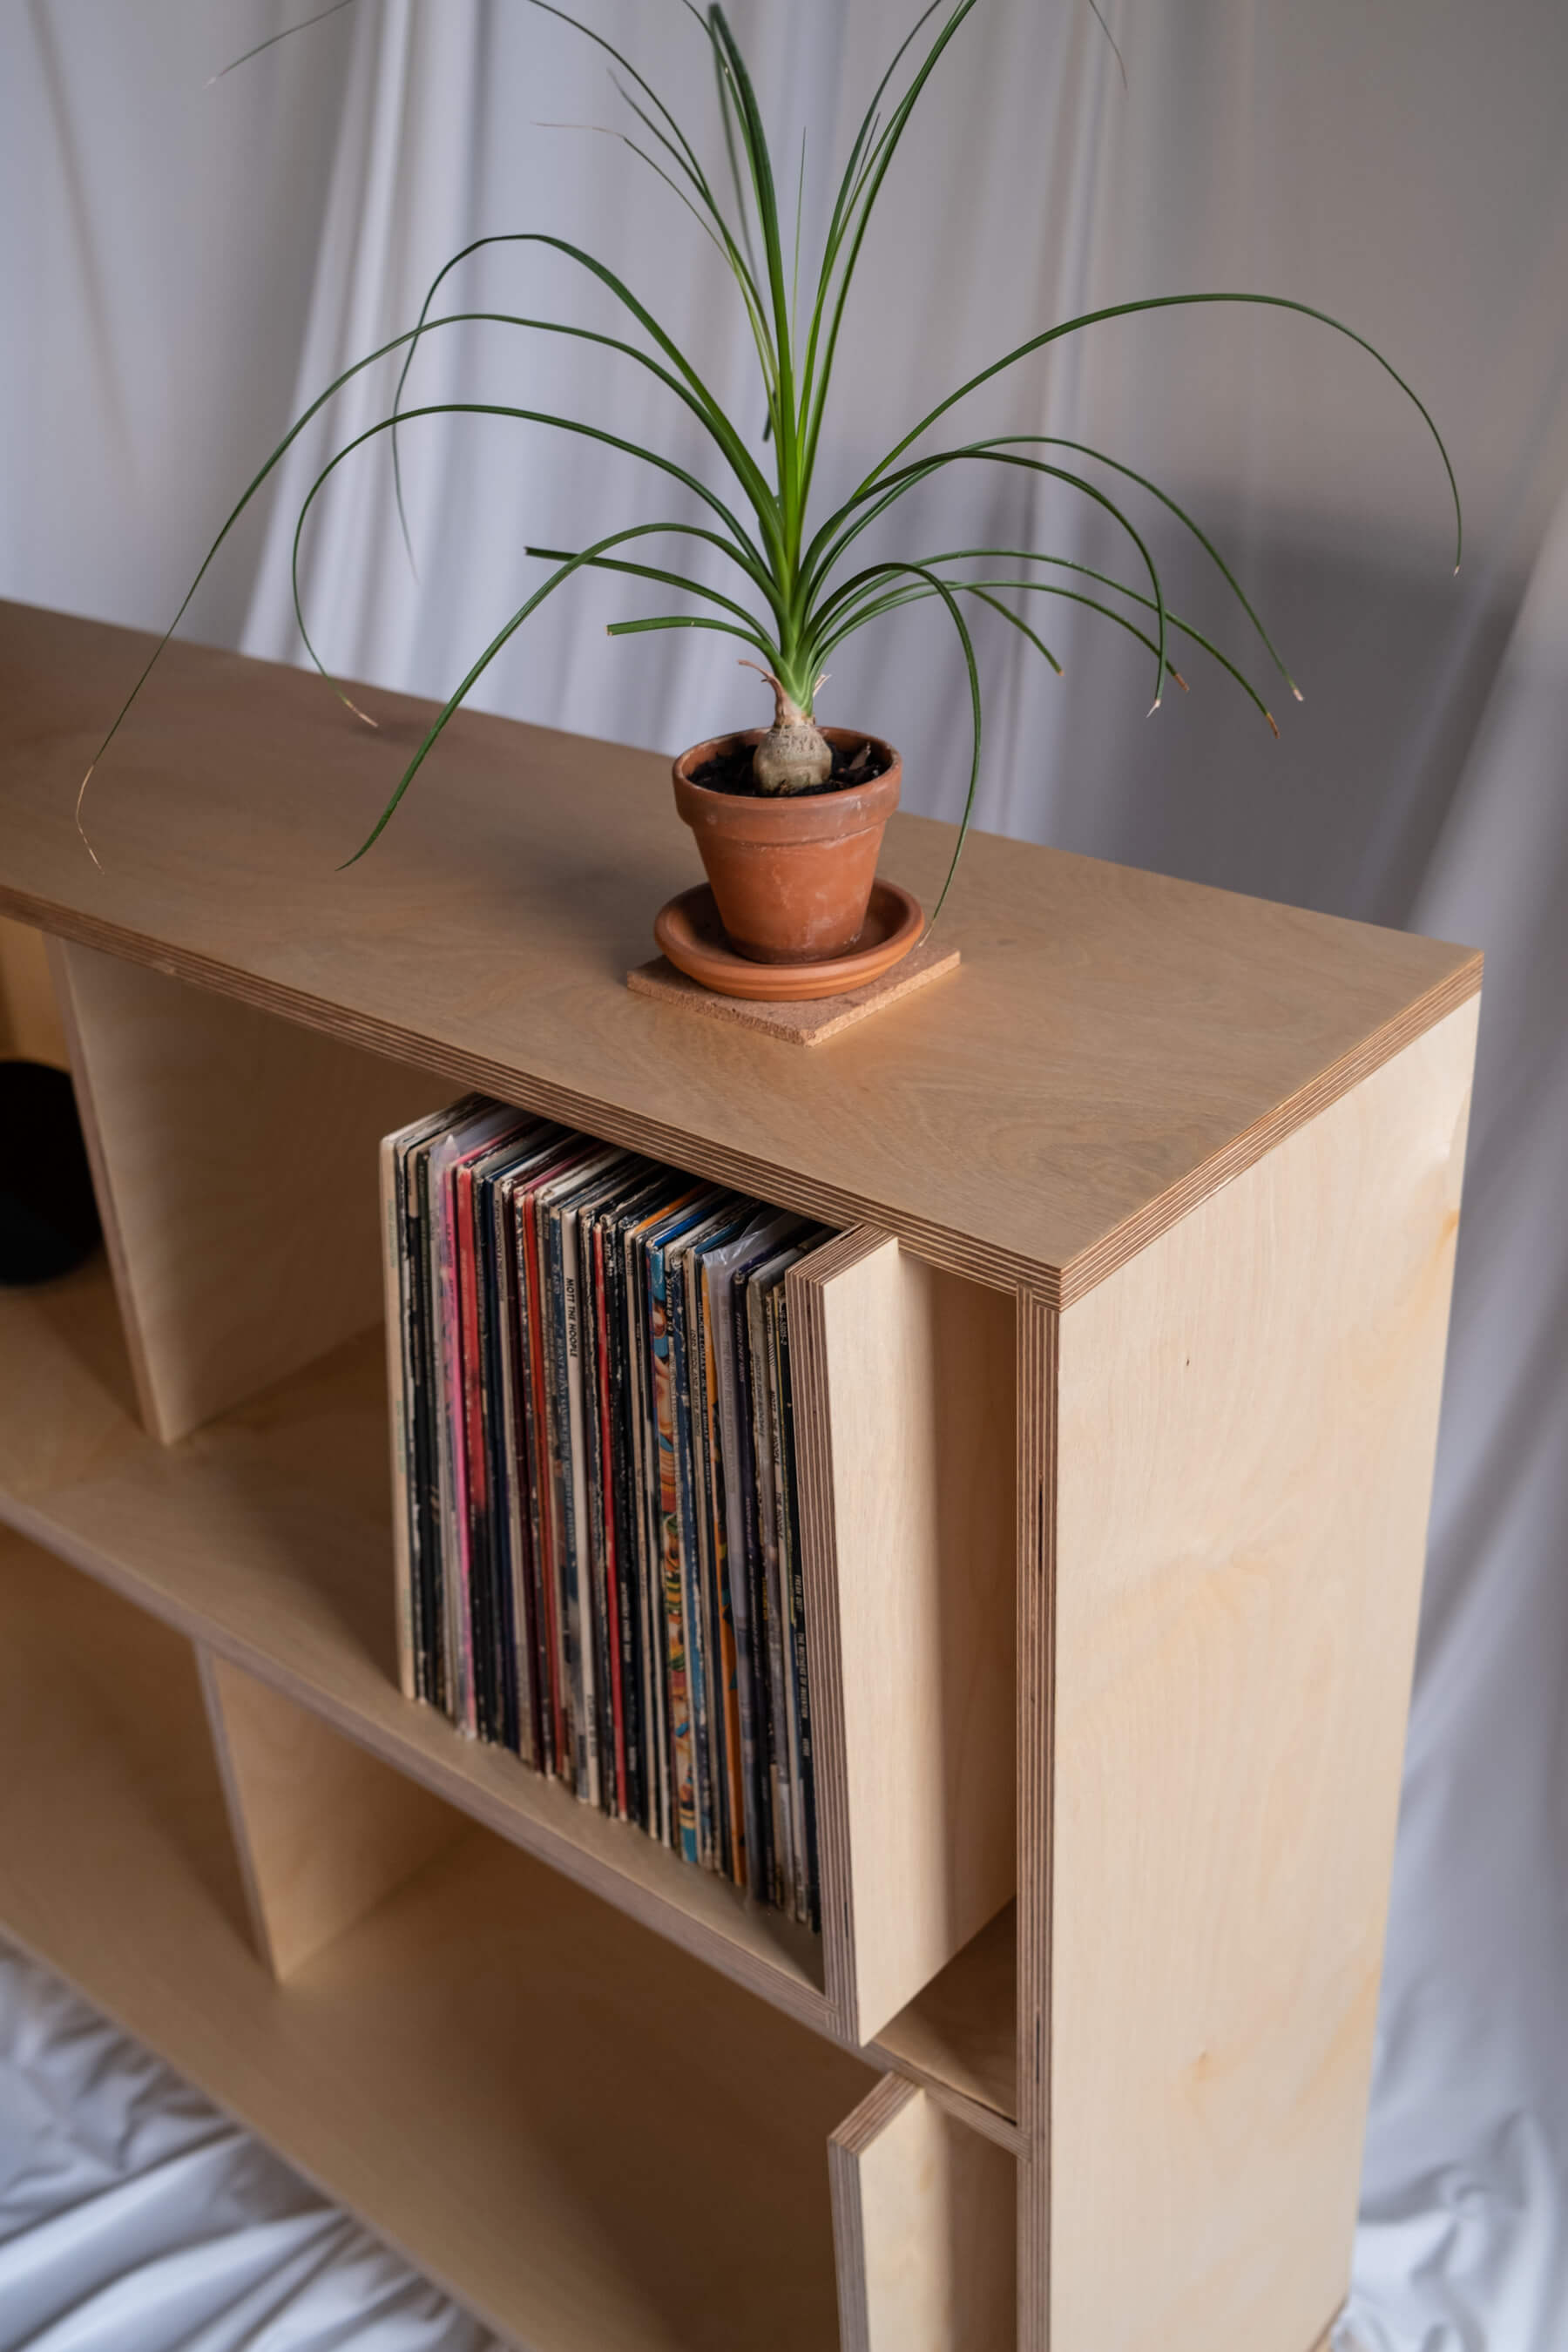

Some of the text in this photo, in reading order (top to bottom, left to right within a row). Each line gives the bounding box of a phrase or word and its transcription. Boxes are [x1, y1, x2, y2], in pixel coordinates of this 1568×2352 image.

[566, 1278, 578, 1357] MOTT THE HOOPLE
[794, 1575, 802, 1595] FREAK
[798, 1646, 807, 1675] MOTHERS
